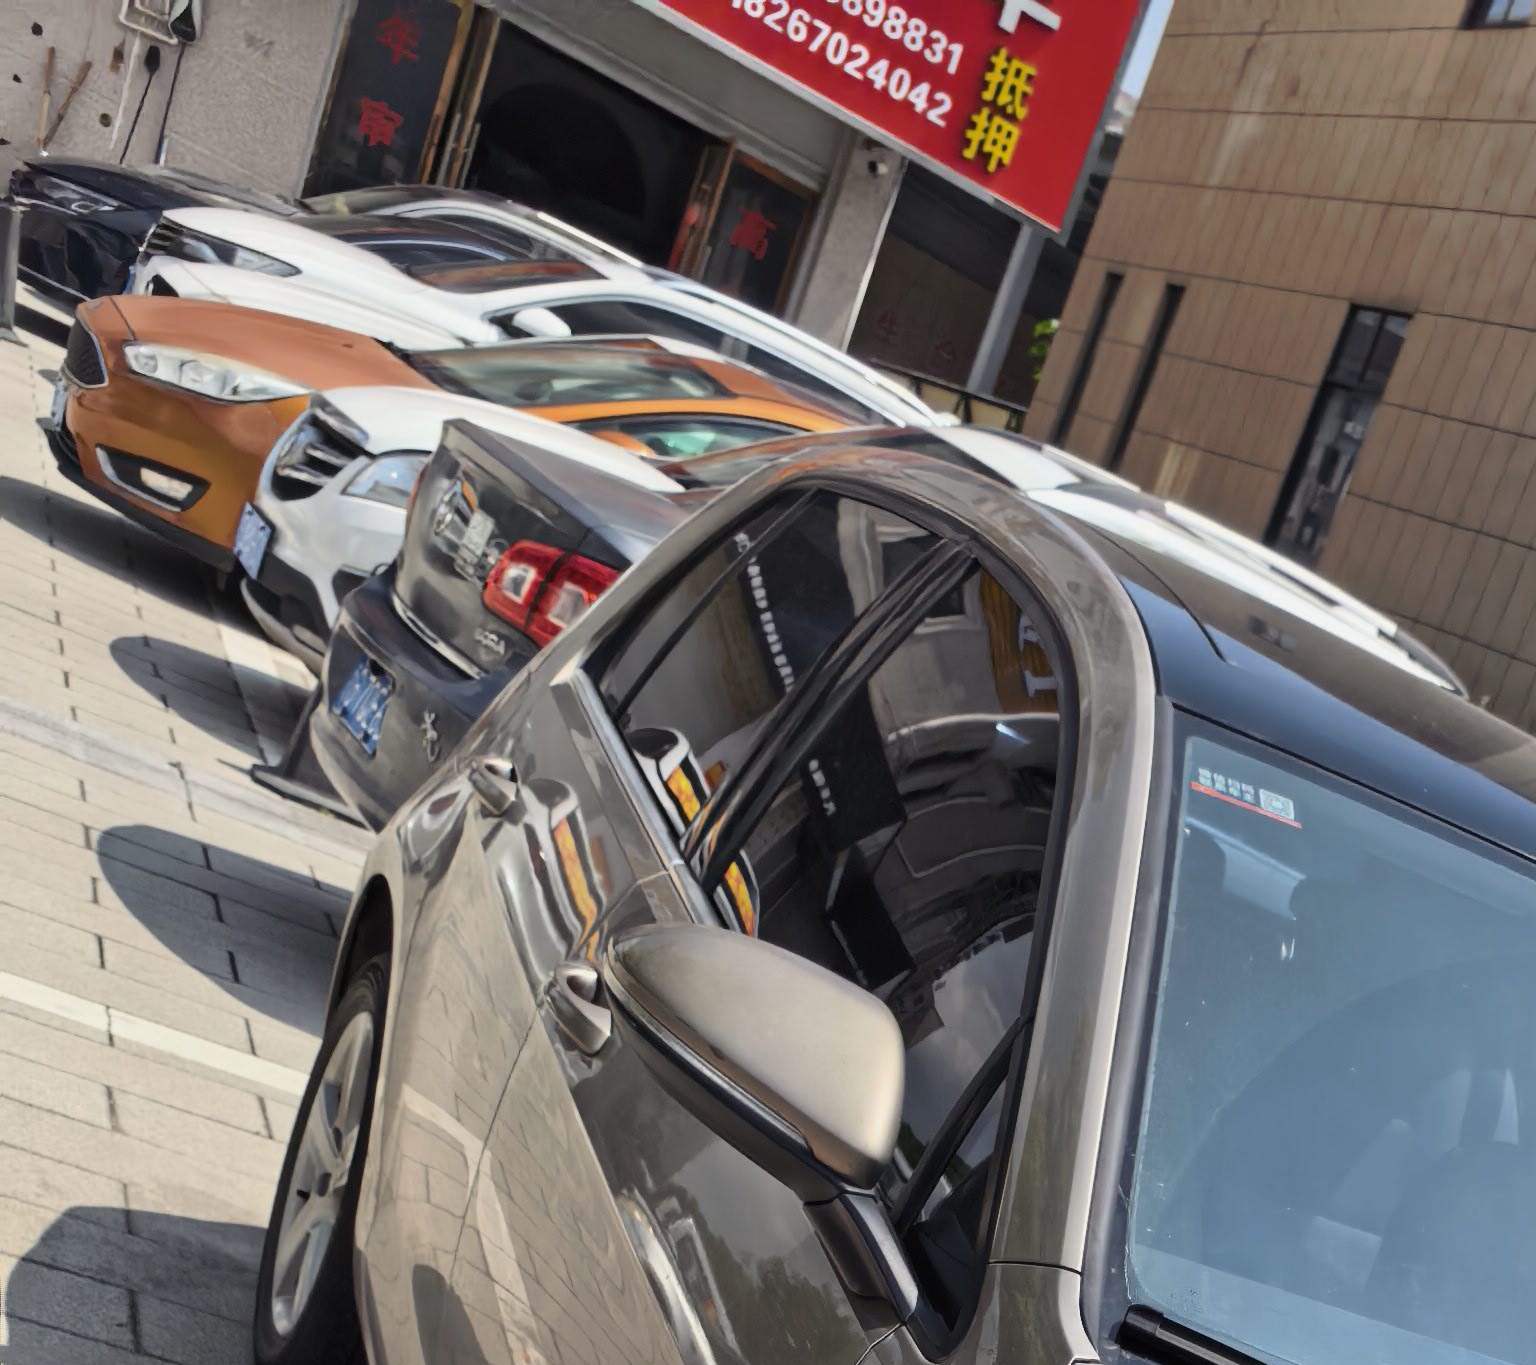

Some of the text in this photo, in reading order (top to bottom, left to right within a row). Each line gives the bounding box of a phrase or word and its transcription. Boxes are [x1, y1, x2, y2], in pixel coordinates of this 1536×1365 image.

[732, 0, 952, 127] 8267024042
[826, 0, 963, 74] 98831
[962, 46, 1037, 173] 抵押
